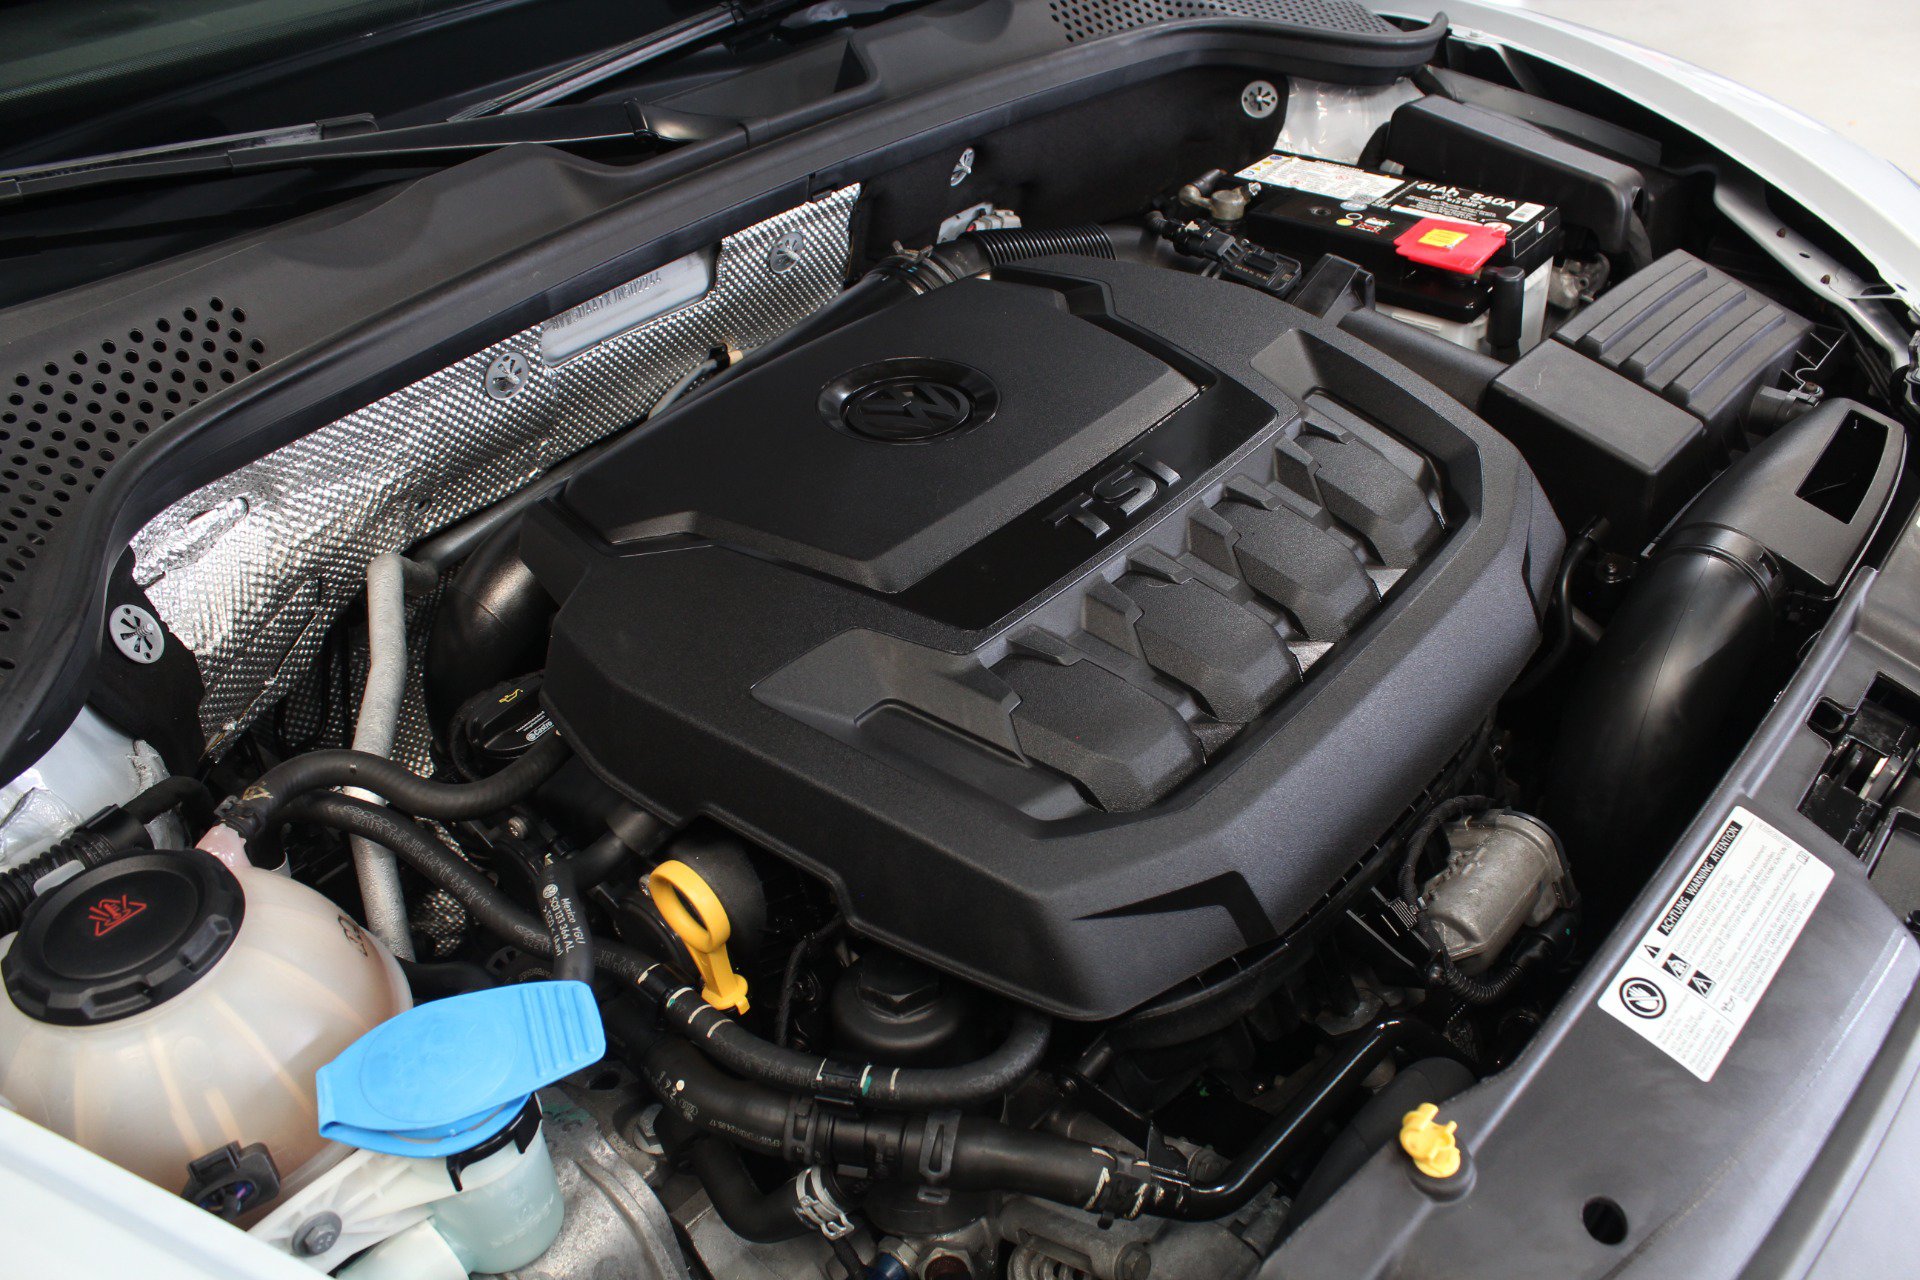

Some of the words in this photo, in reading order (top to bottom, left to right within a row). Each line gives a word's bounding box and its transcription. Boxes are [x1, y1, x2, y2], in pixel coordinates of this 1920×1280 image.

[1416, 182, 1460, 198] 61Ah
[1469, 192, 1517, 209] 540A
[1041, 452, 1182, 539] TSI
[1659, 895, 1691, 933] ACHTUNG
[1685, 860, 1715, 896] WARNING
[1708, 824, 1740, 862] ATTENTION
[560, 897, 577, 924] Mexico
[554, 911, 566, 925] 133
[563, 939, 576, 954] AL
